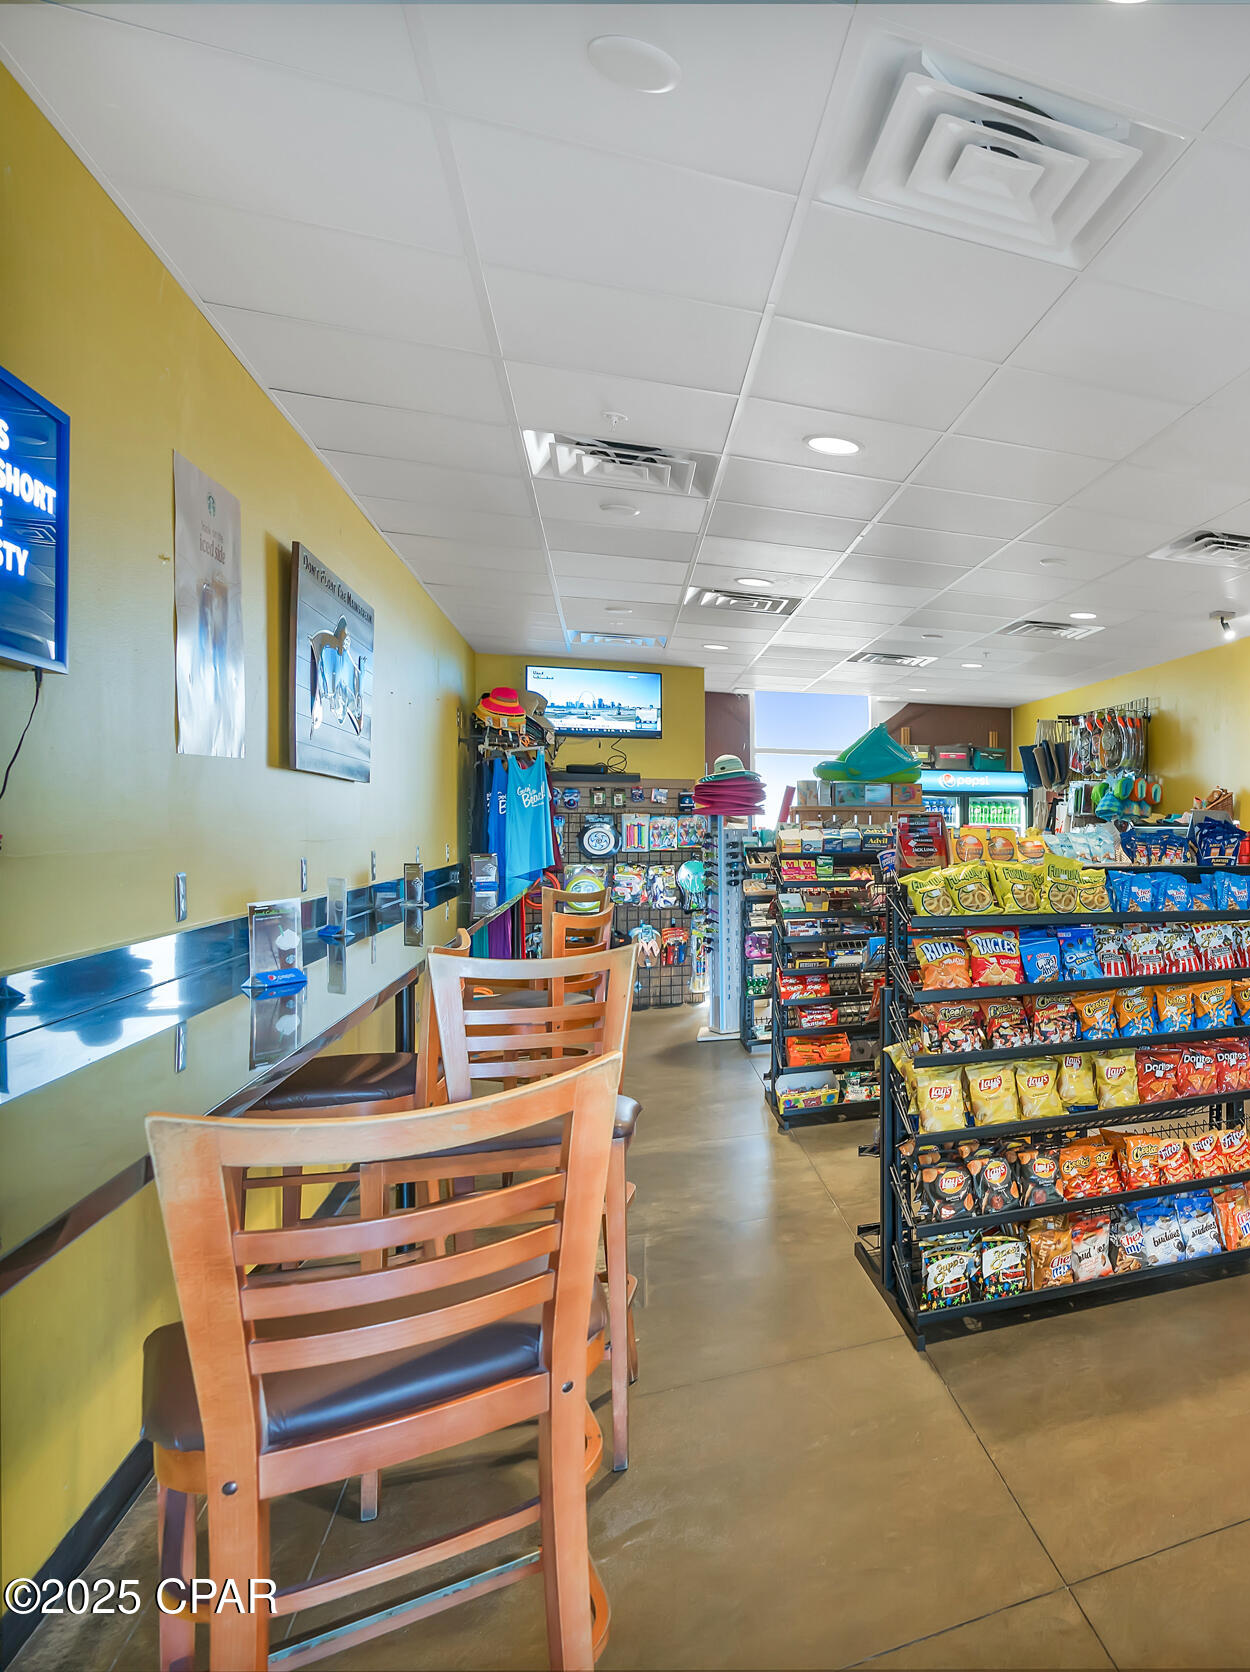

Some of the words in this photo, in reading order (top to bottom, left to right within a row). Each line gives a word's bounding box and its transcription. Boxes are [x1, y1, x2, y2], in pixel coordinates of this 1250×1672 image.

[957, 776, 989, 787] pepsi
[972, 935, 1017, 956] BUGLES
[1200, 987, 1226, 1003] Cheetos
[1083, 998, 1110, 1017] Cheetos
[1217, 1052, 1247, 1063] Doritos
[1221, 1129, 1245, 1146] Fritos
